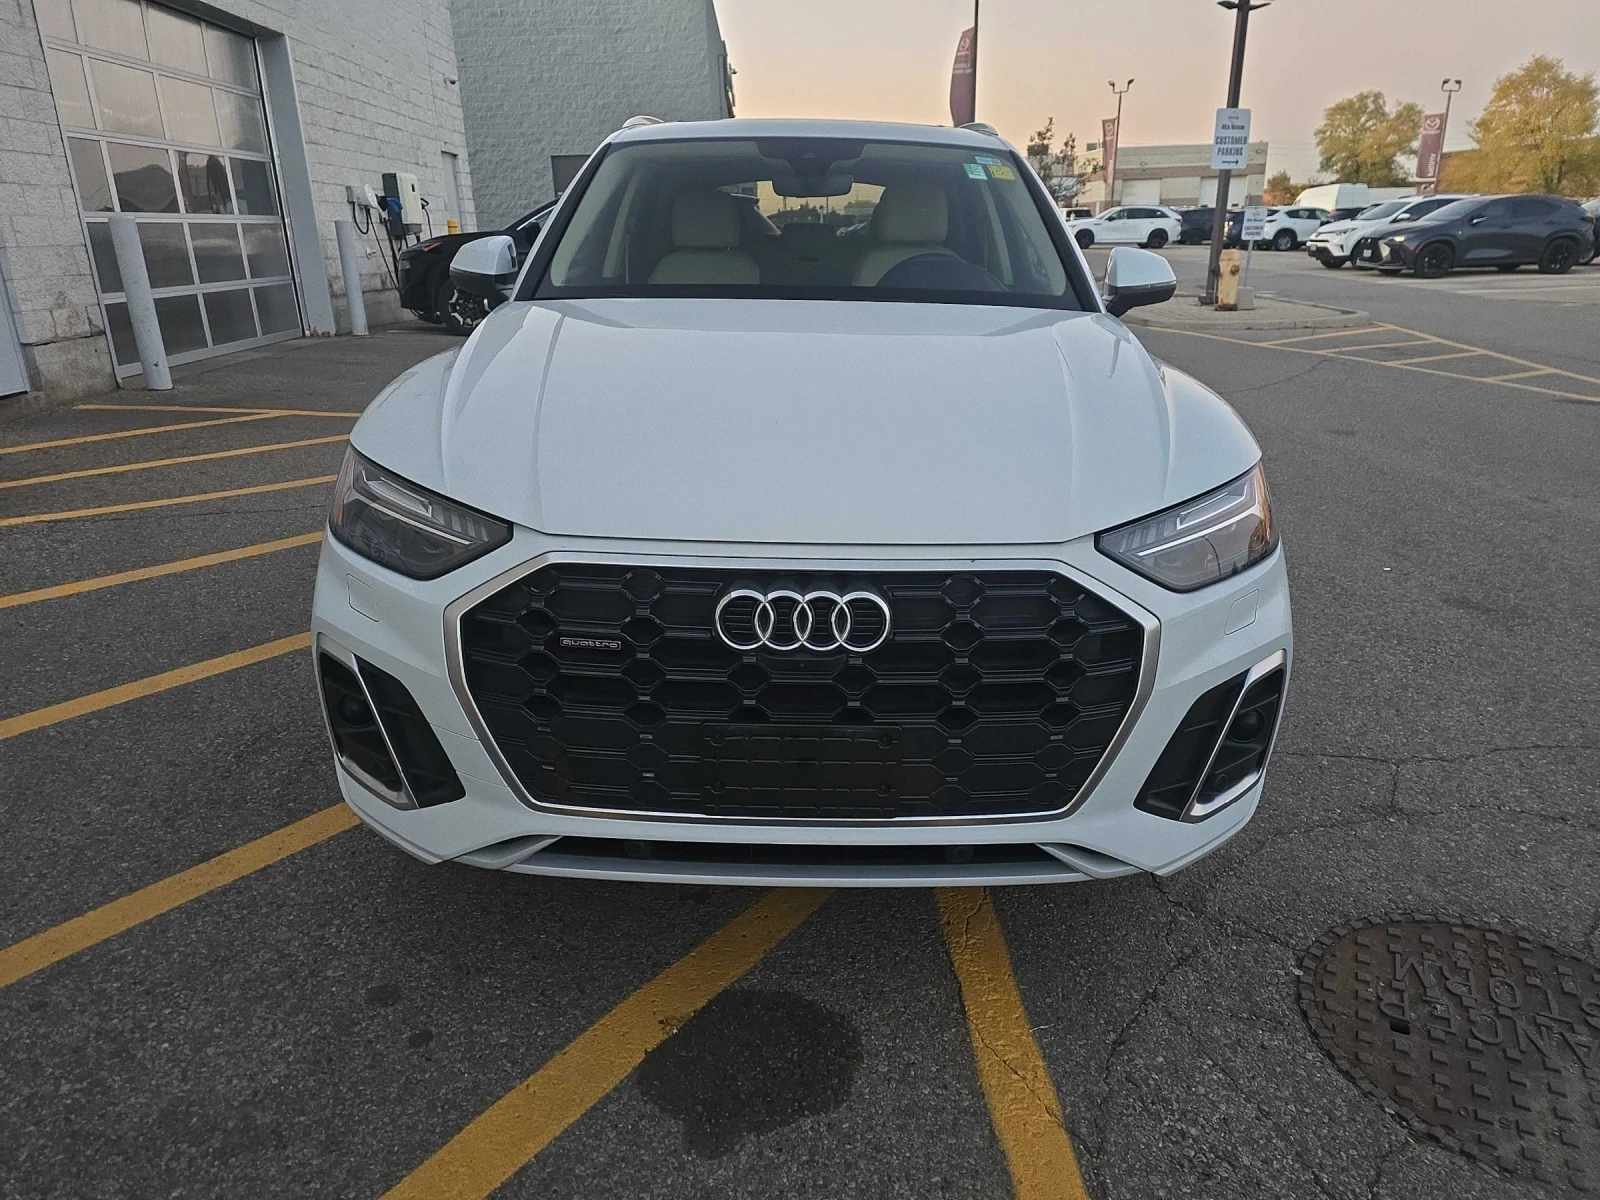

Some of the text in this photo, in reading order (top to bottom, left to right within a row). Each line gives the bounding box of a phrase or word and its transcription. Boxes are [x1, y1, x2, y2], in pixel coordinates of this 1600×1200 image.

[1215, 135, 1248, 145] CUSTOMER
[1217, 147, 1244, 156] PARKING
[562, 639, 618, 648] quattro
